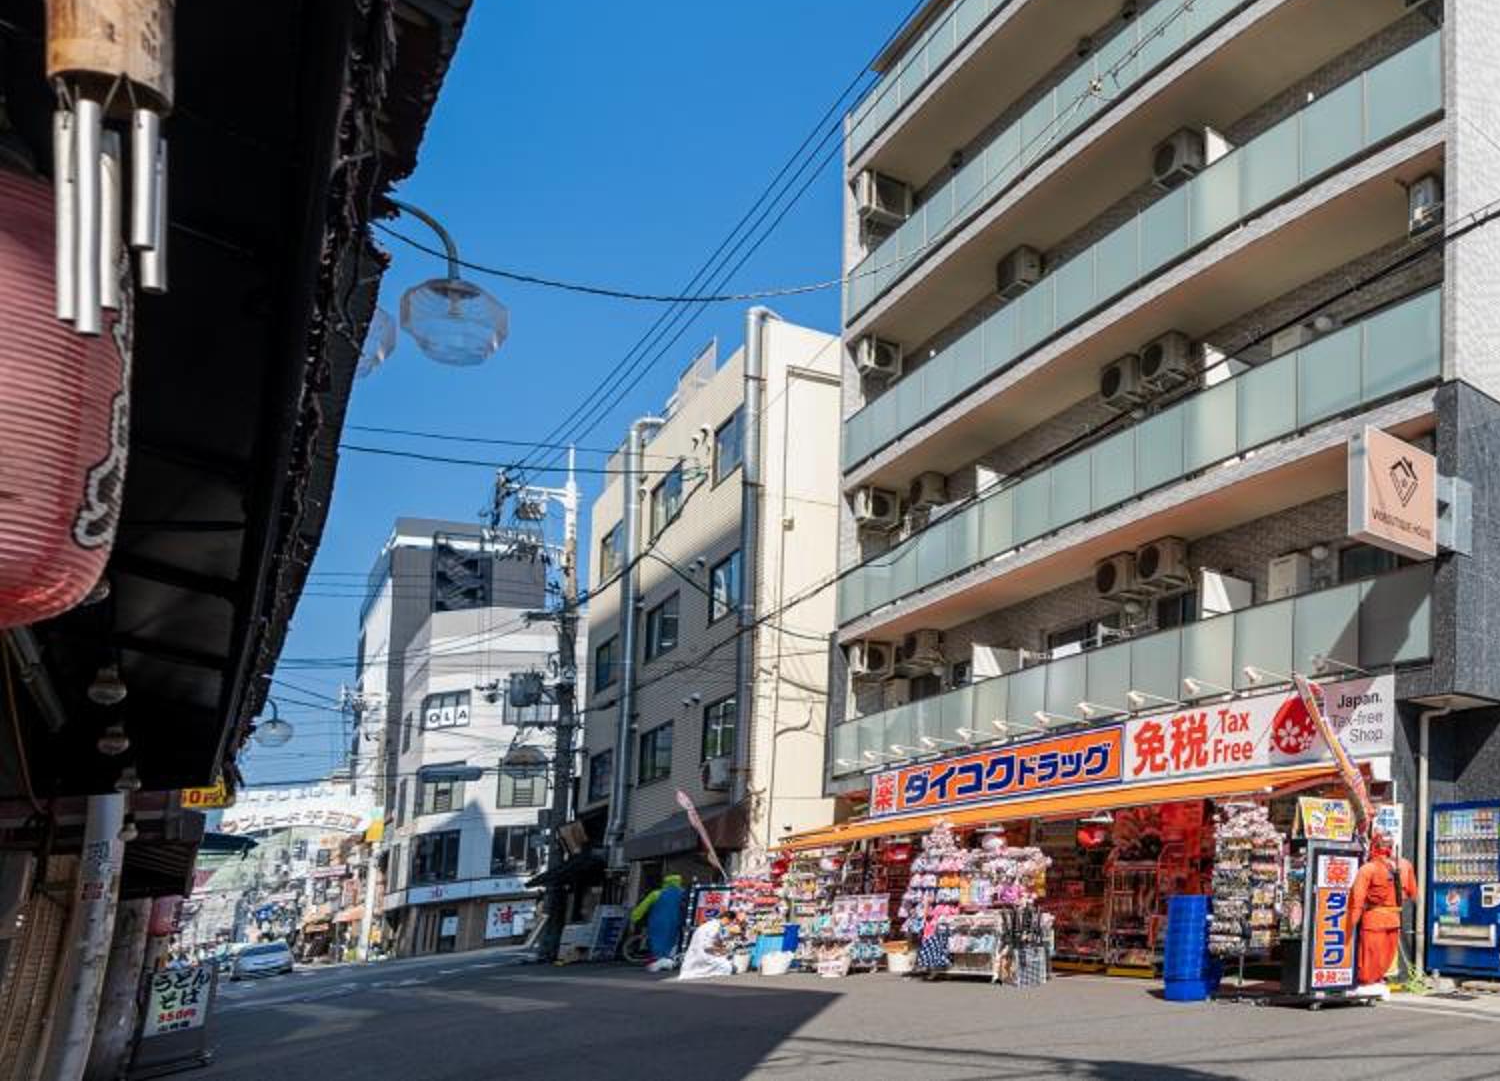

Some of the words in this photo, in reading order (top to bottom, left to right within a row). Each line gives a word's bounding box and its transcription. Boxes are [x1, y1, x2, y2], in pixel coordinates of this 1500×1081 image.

[1337, 692, 1383, 710] Japan.
[1218, 708, 1250, 734] Tax
[1331, 712, 1384, 729] Tax-free
[1133, 712, 1209, 776] 免税
[1350, 728, 1384, 744] Shop
[1213, 738, 1254, 764] Free
[904, 741, 1112, 806] ダイコクドラッグ
[1323, 892, 1346, 966] ダイコク
[154, 969, 210, 992] うどん
[160, 989, 200, 1010] そば
